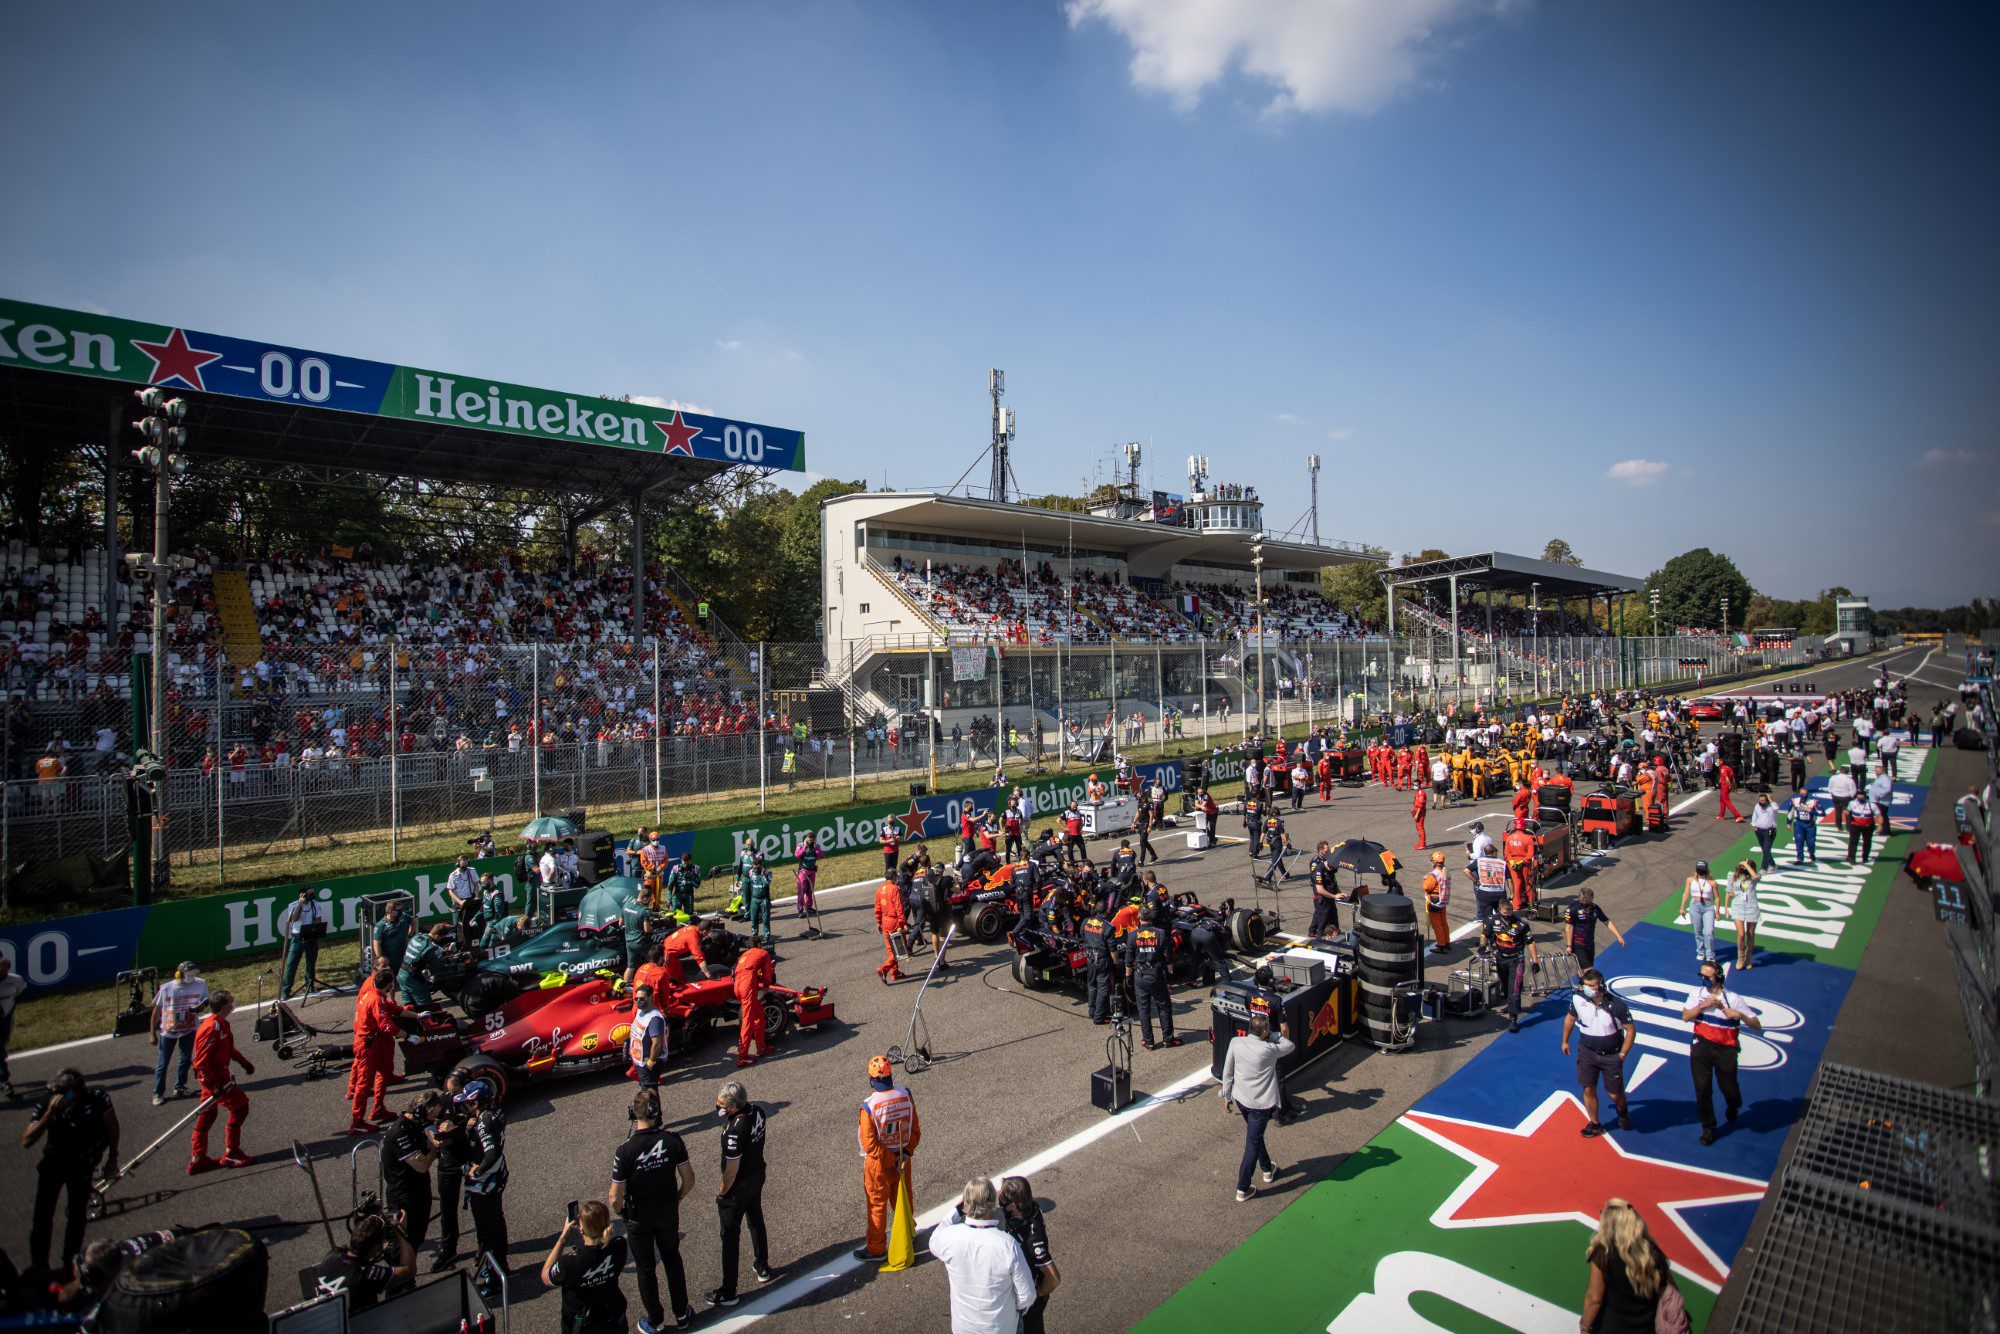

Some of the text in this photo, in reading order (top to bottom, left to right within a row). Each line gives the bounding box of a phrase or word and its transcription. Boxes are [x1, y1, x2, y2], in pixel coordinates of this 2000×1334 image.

[260, 351, 332, 402] 0.0
[415, 373, 649, 446] Heineken
[723, 424, 764, 462] 0.0
[975, 890, 1006, 900] HONDA
[1936, 883, 1966, 910] 11
[1146, 938, 1158, 946] Bull
[509, 961, 534, 974] BWT
[557, 954, 621, 975] Cognizant
[484, 1010, 505, 1031] 55
[426, 1031, 457, 1042] V-Power
[489, 1028, 506, 1038] aws
[521, 1026, 574, 1055] Ray-Ban
[583, 1037, 598, 1048] ups
[636, 1157, 669, 1170] ALPINE
